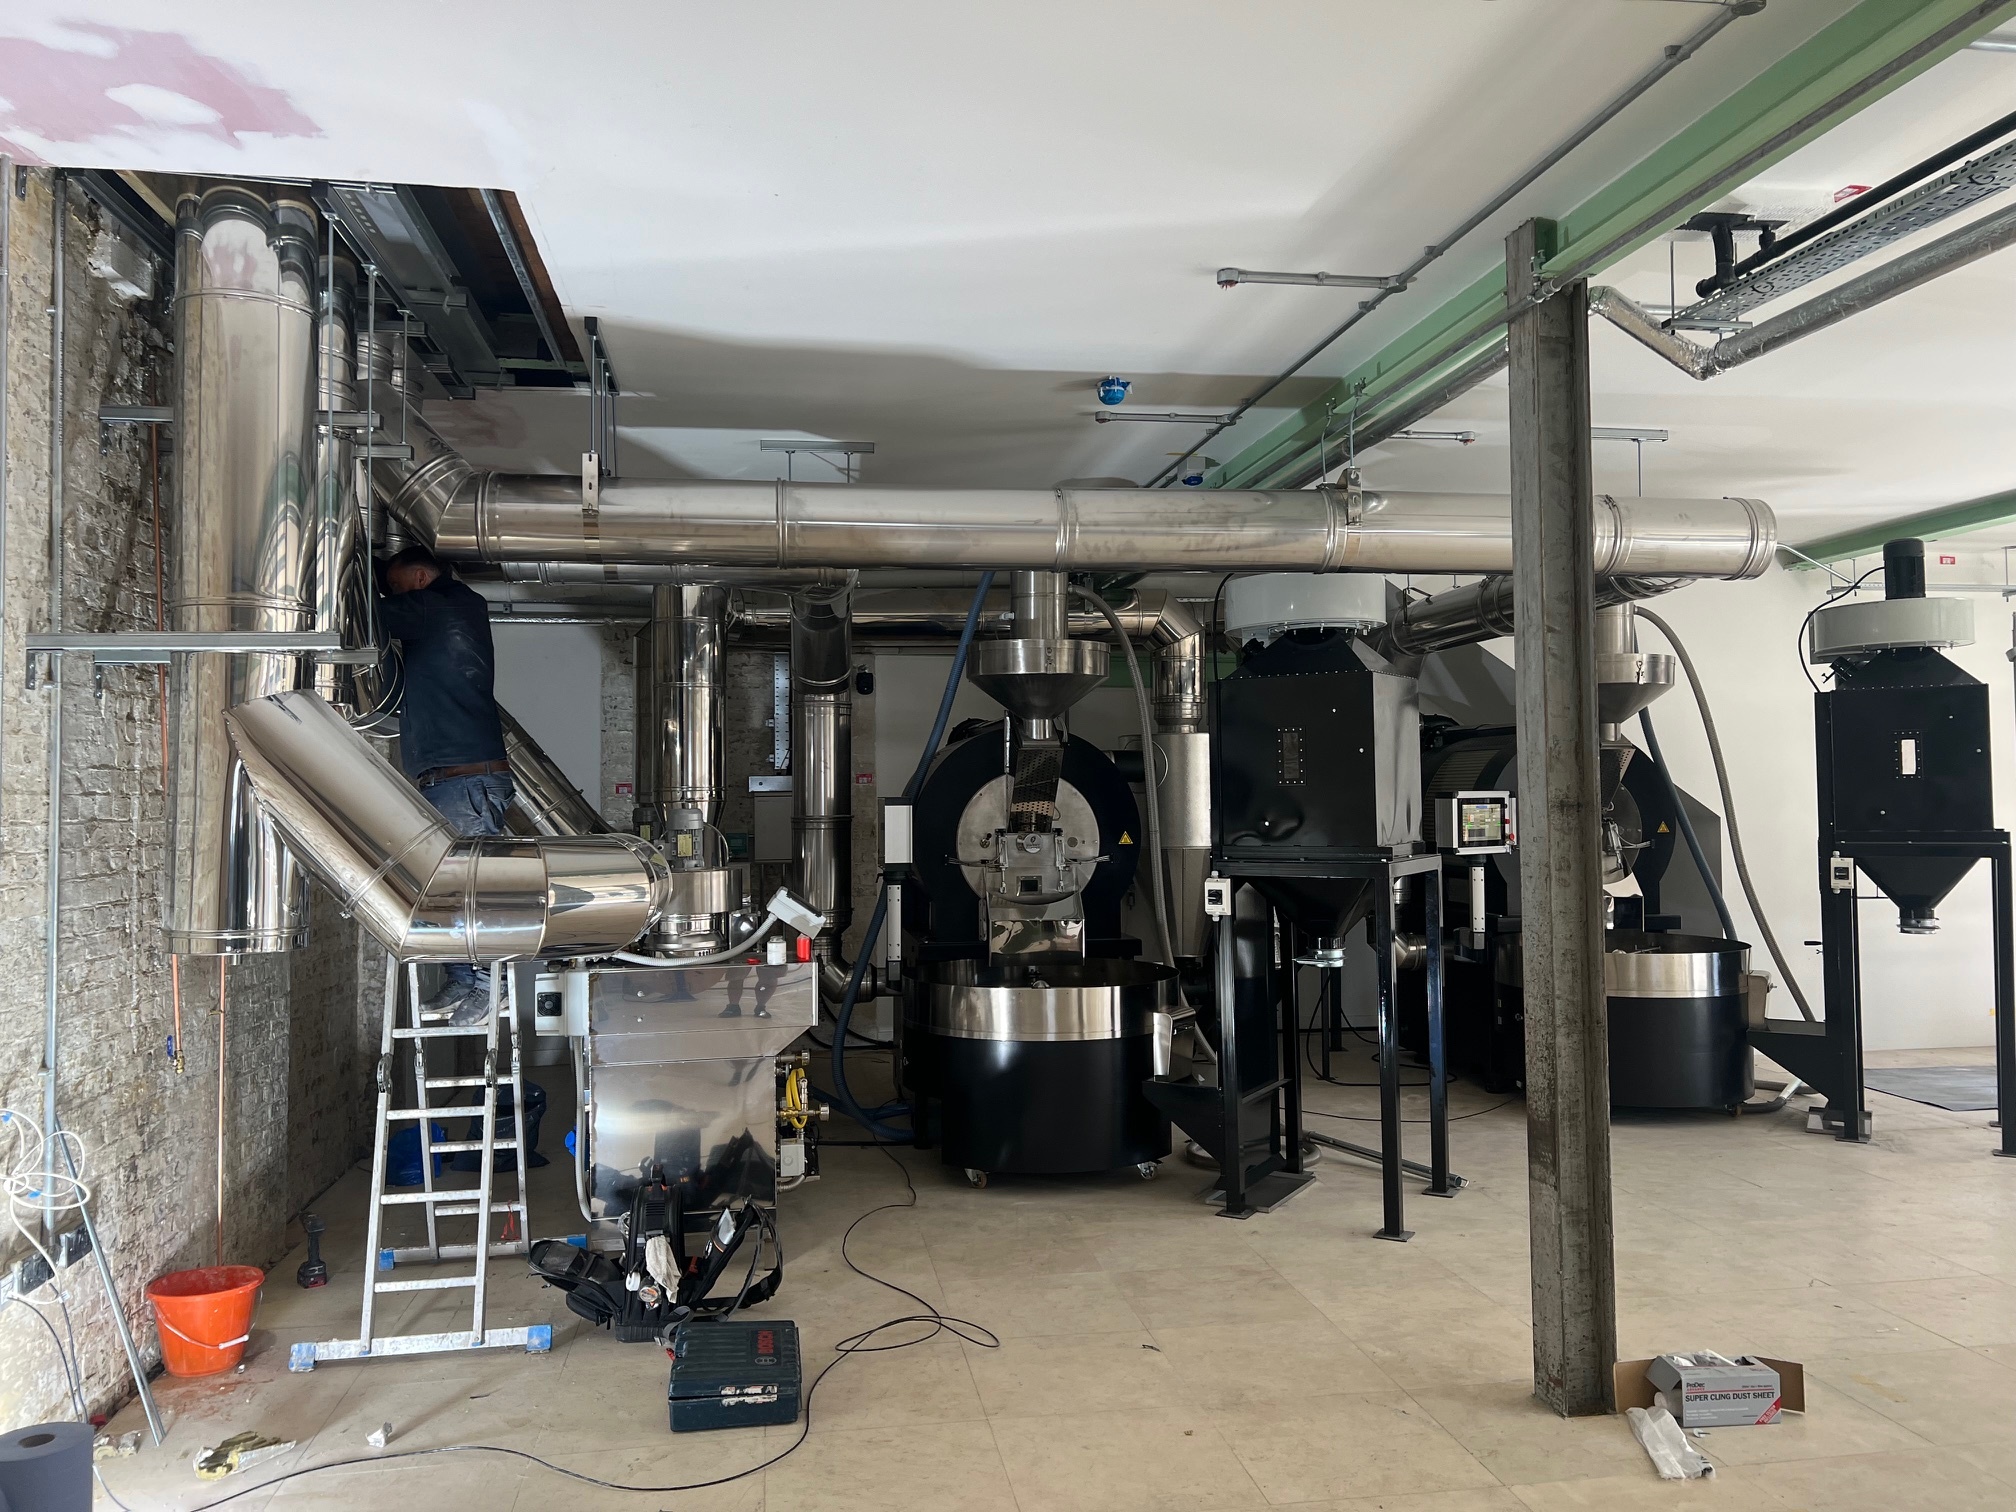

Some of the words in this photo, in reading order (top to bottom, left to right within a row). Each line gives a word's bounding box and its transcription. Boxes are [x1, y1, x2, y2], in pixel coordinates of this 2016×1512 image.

[758, 1331, 773, 1353] BOSCH
[1685, 1394, 1709, 1402] SUPER
[1710, 1393, 1731, 1401] CLING
[1732, 1392, 1751, 1400] DUST
[1752, 1391, 1775, 1399] SHEET
